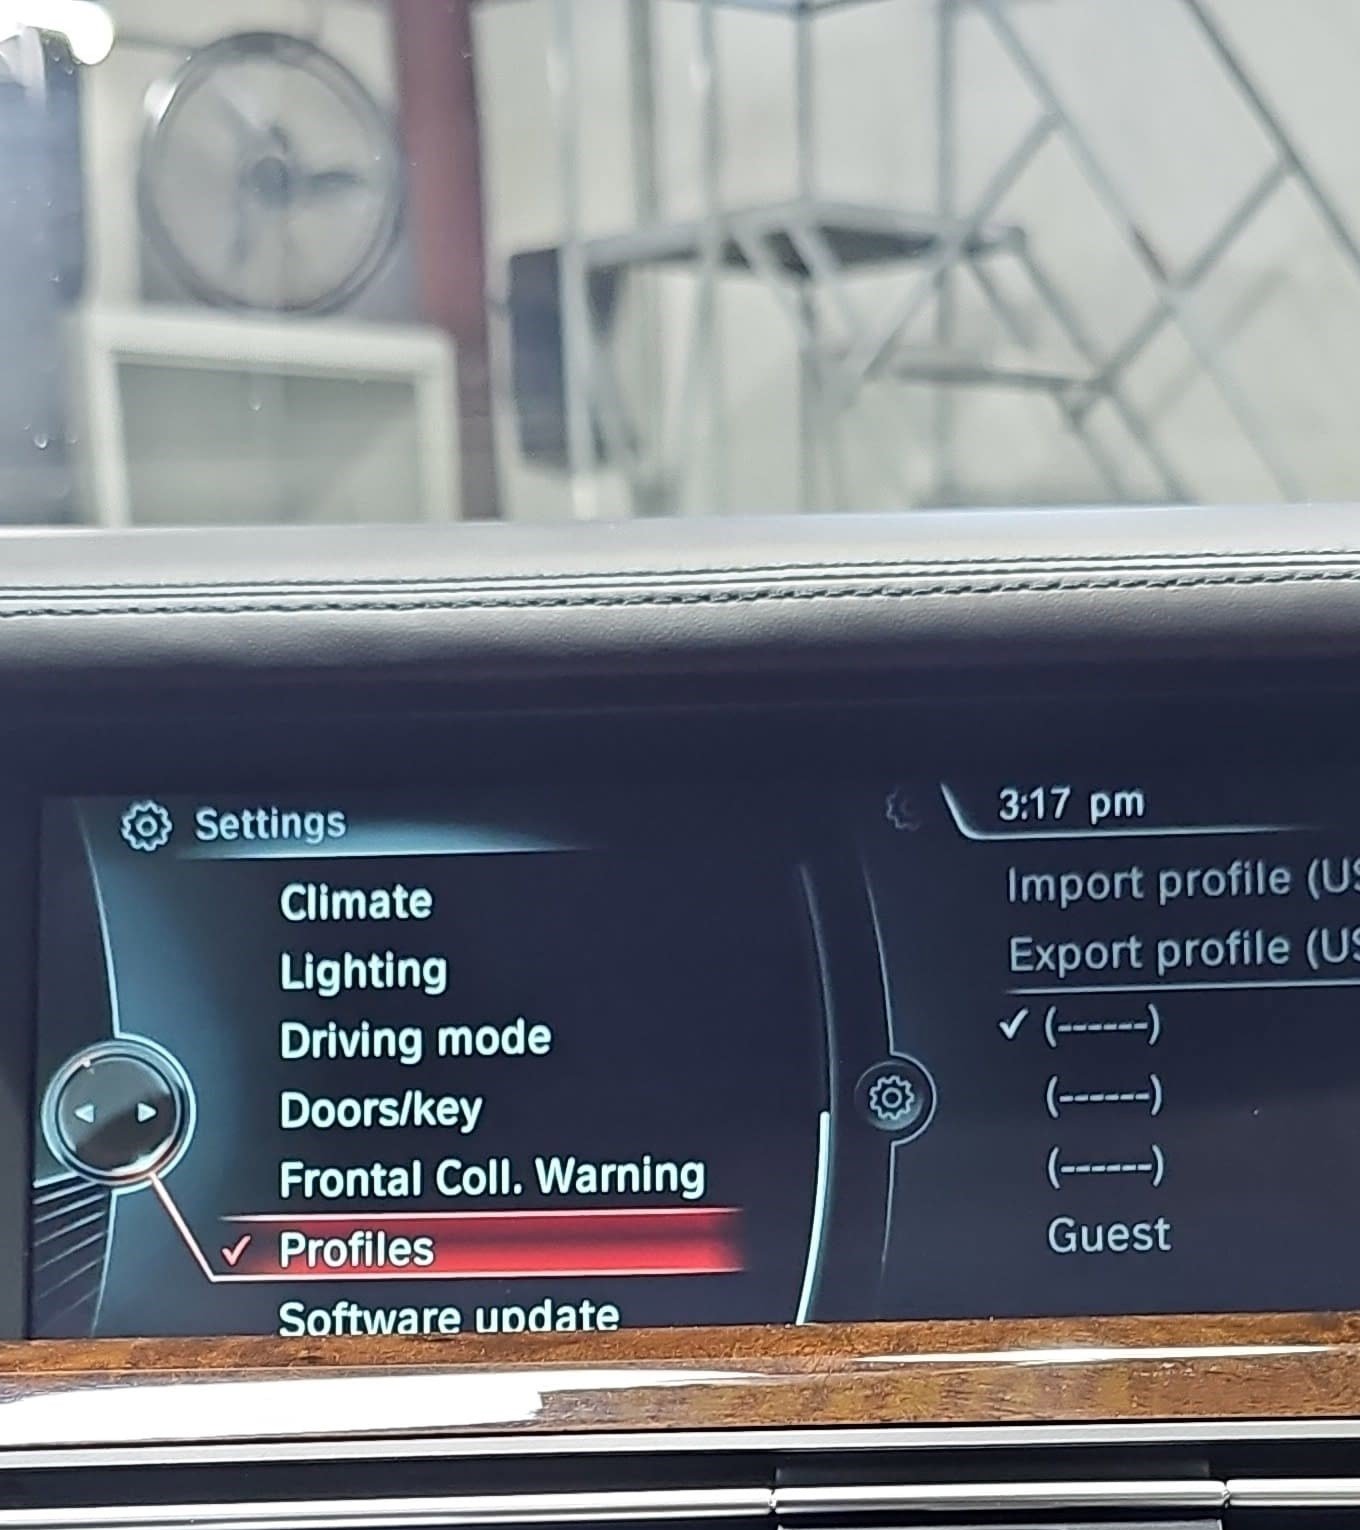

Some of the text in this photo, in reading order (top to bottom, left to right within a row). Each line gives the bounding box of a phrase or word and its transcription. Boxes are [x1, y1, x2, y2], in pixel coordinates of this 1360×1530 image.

[195, 808, 347, 844] Settings
[998, 786, 1145, 825] 3:17 pm
[280, 883, 433, 921] Climate
[1008, 866, 1144, 909] Import
[1159, 860, 1291, 906] profile
[280, 950, 447, 997] Lighting
[1009, 935, 1143, 979] Export
[1157, 929, 1290, 975] profile
[280, 1017, 552, 1066] Driving mode
[280, 1090, 483, 1134] Doors/key
[280, 1155, 706, 1200] Frontal Coll. Warning
[280, 1231, 436, 1269] Profiles
[1048, 1216, 1172, 1254] Guest
[279, 1298, 621, 1338] Software update
